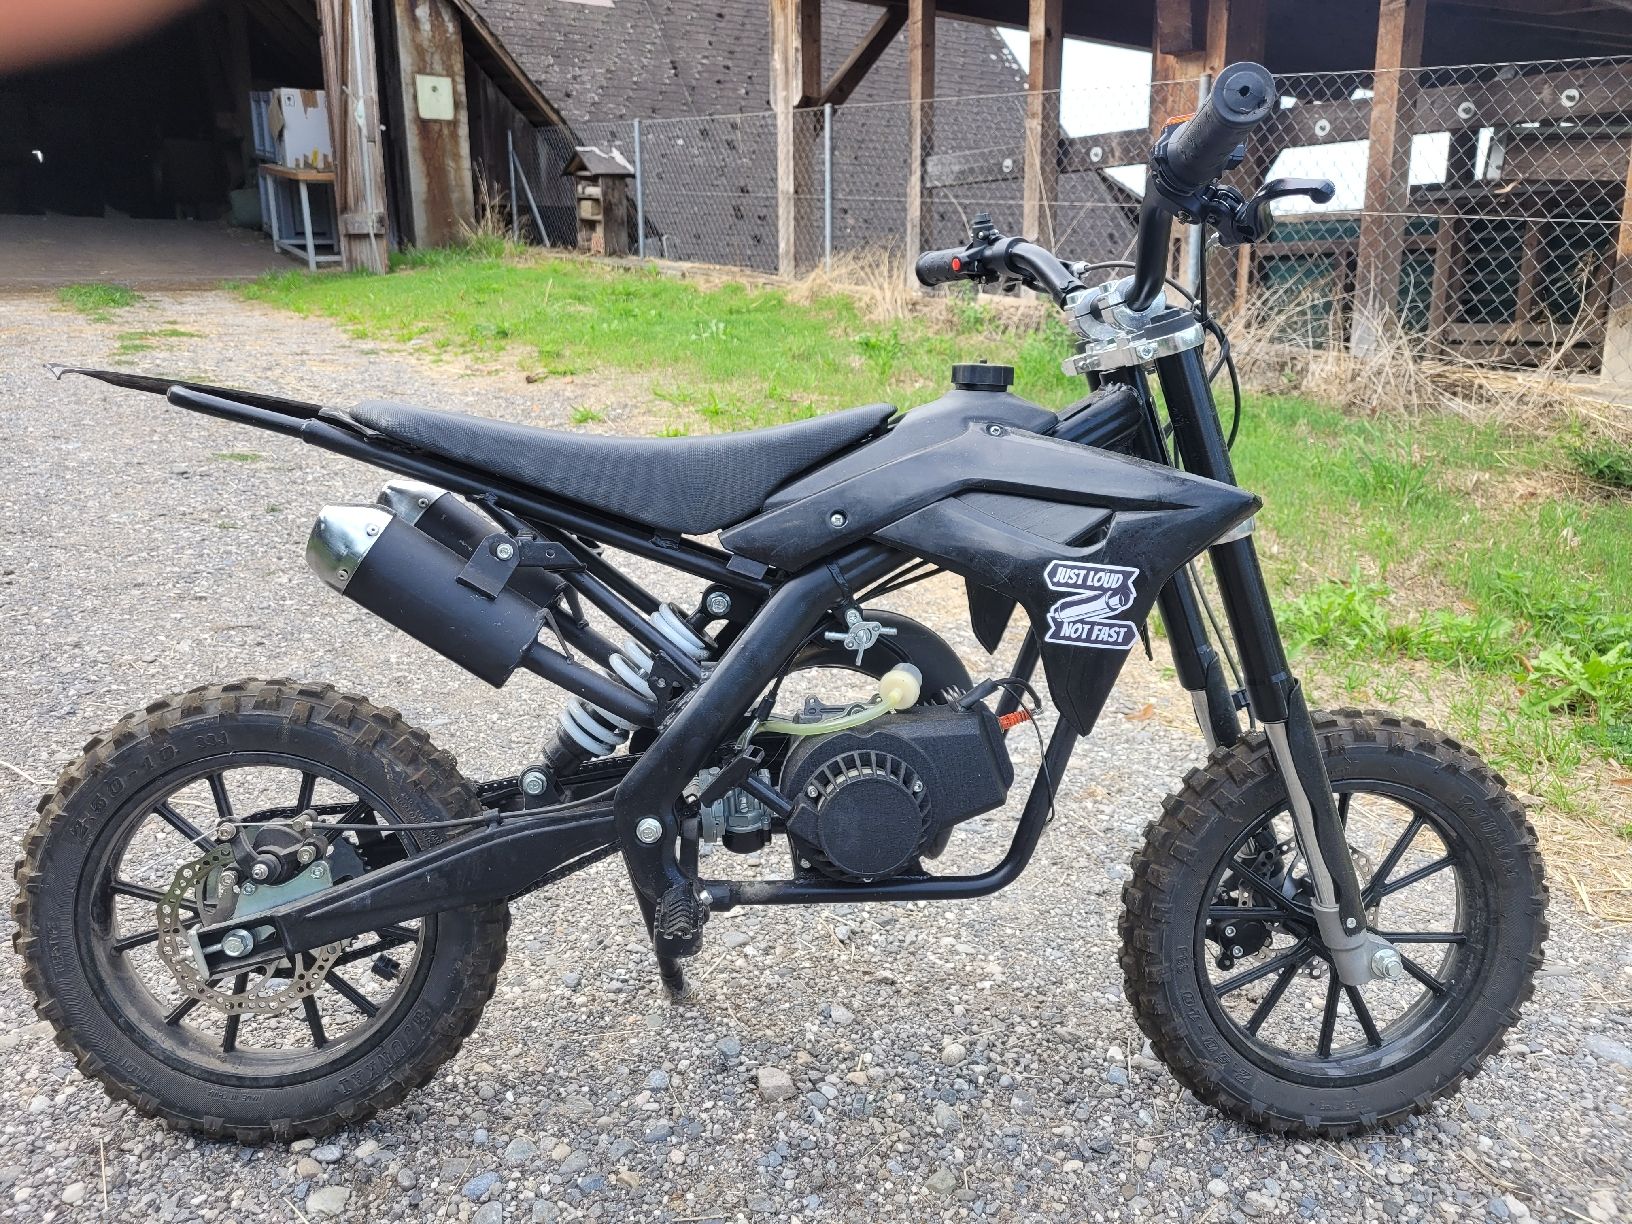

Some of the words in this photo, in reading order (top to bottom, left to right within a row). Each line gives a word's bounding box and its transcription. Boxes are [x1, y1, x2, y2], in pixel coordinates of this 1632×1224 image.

[1053, 566, 1087, 585] JUST
[1086, 571, 1124, 589] LOUD
[1060, 622, 1091, 639] NOT
[1091, 625, 1128, 642] FAST
